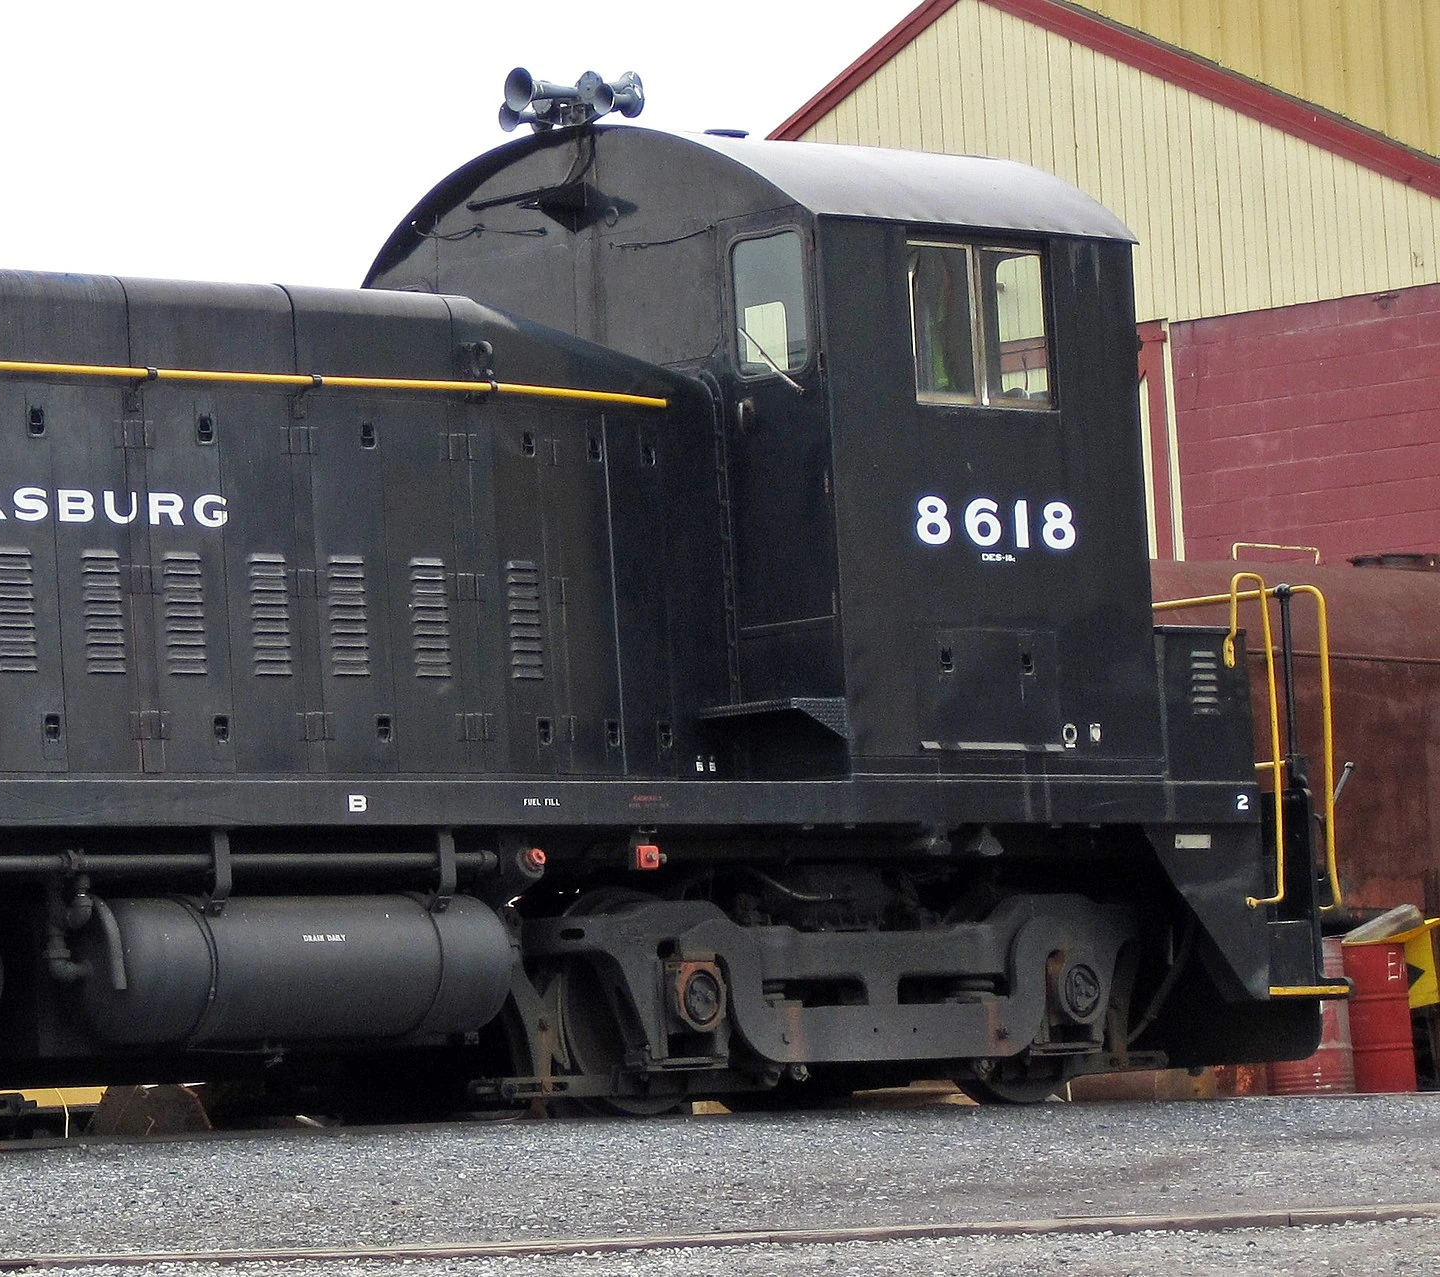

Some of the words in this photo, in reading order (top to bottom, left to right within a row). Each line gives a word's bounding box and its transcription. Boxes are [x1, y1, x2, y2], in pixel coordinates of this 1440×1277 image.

[916, 495, 1076, 550] 8618
[348, 794, 367, 812] B
[523, 798, 542, 806] FUEL
[544, 798, 561, 806] FILL
[1236, 794, 1249, 810] 2
[302, 934, 325, 942] DRAIN
[325, 934, 346, 942] DAILY
